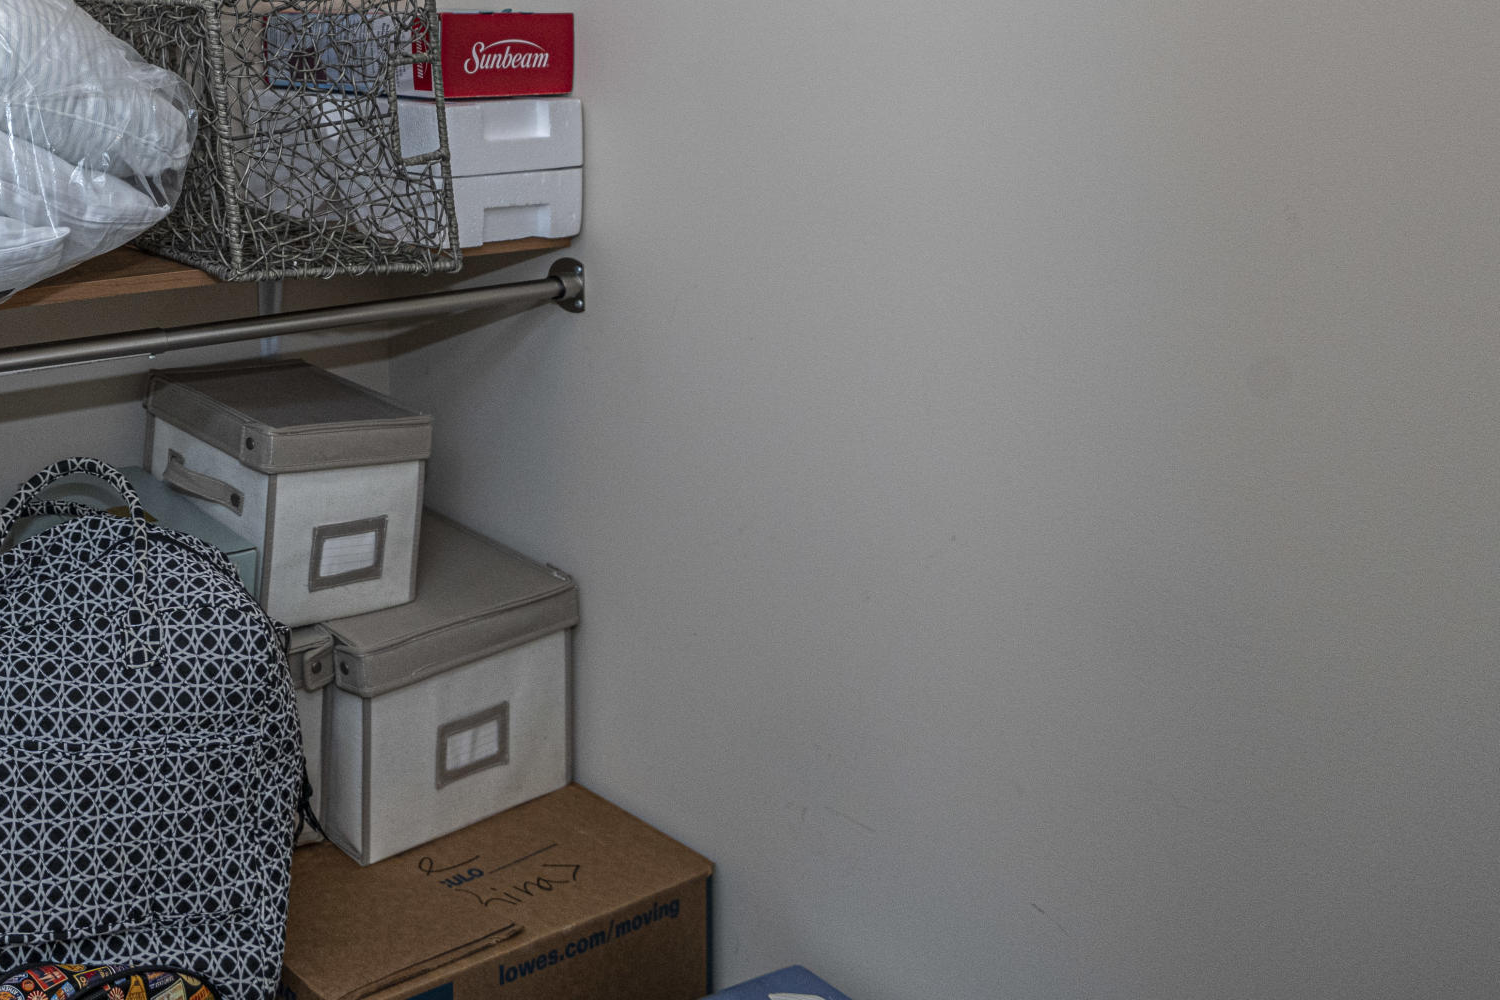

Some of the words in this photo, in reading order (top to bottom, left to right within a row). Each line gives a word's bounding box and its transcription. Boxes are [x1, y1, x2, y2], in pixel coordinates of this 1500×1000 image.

[463, 40, 549, 75] Sunbeam
[439, 867, 485, 889] ULO
[498, 898, 680, 985] lowes.com/moving
